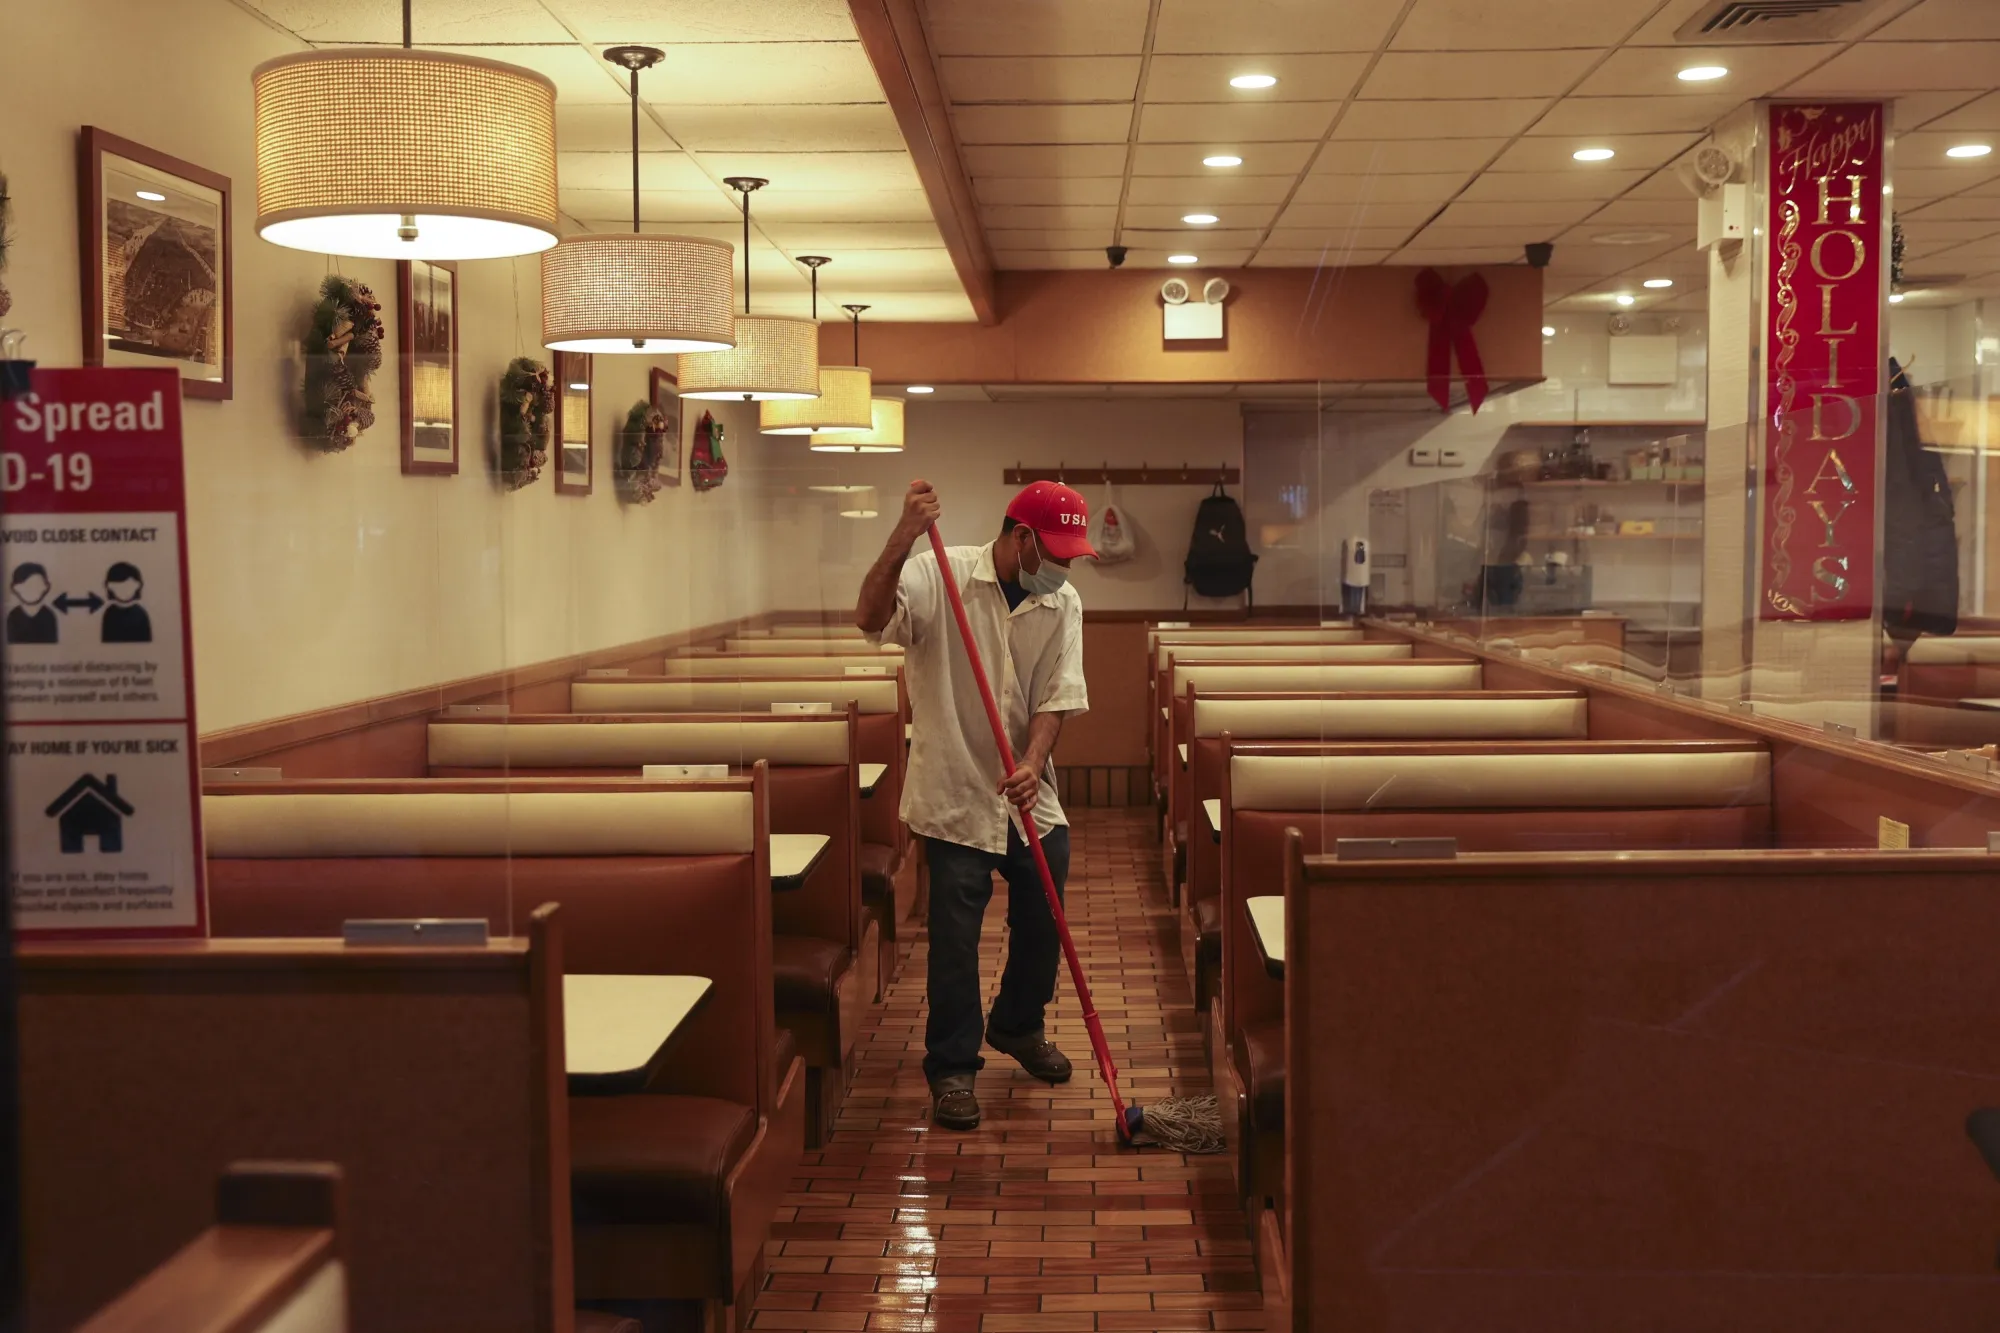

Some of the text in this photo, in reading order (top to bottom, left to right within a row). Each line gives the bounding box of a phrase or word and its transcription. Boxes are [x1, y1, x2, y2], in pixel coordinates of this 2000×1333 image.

[1779, 108, 1877, 195] Happy
[1803, 173, 1867, 602] HOLIDAYS
[16, 390, 164, 442] Spread
[0, 527, 158, 543] VOID CLOSE CONTACT
[1060, 513, 1087, 527] USA
[30, 740, 74, 755] HOME
[76, 740, 90, 754] IF
[92, 739, 142, 754] YOU'RE
[145, 739, 178, 754] SICK
